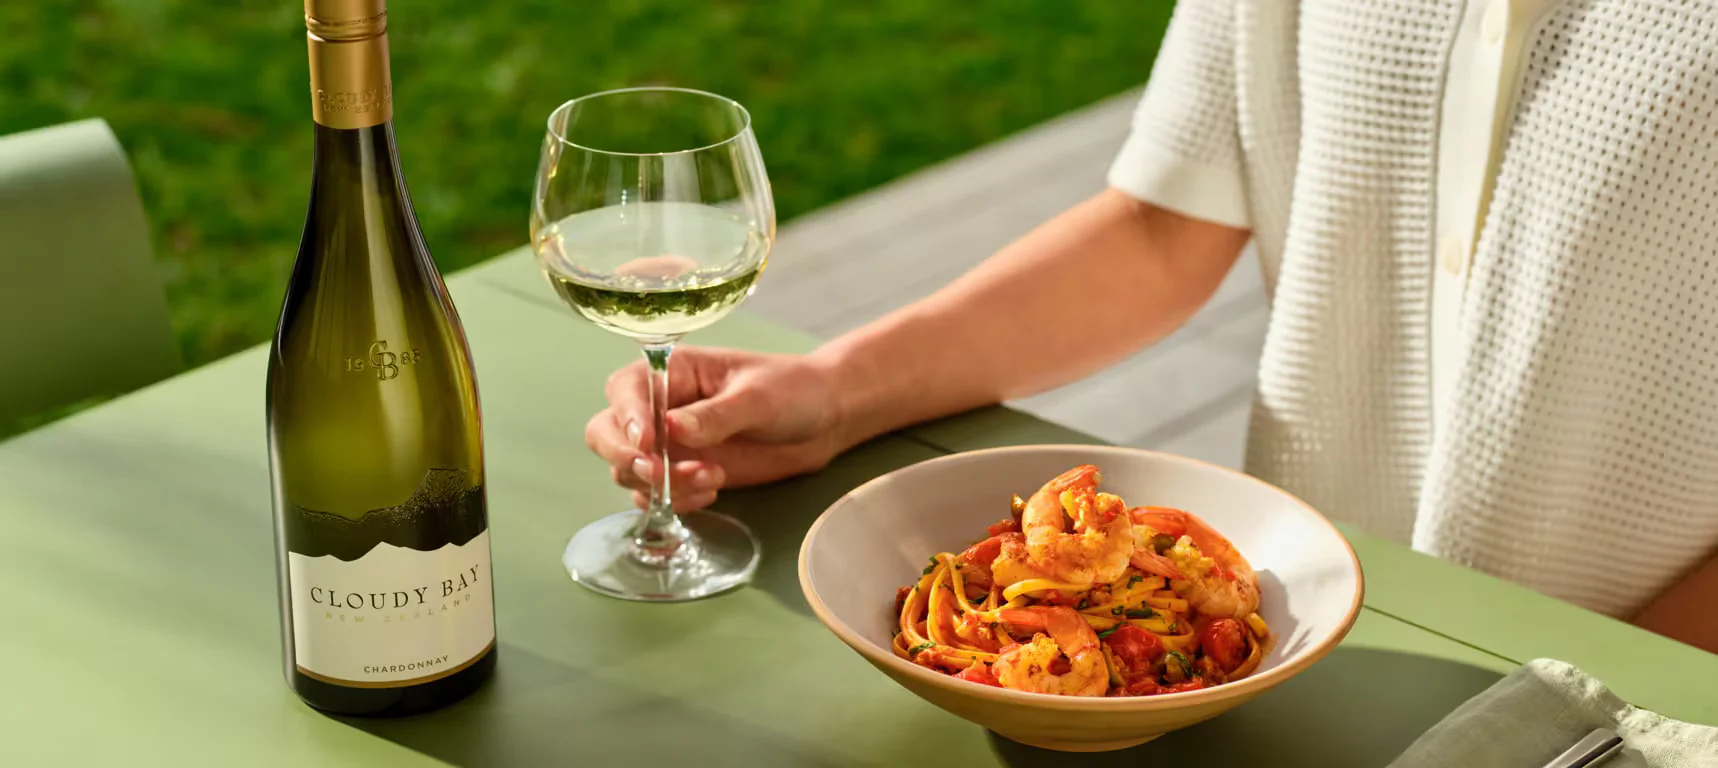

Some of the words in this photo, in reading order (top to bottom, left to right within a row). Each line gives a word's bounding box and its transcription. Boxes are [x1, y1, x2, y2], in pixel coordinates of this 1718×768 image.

[310, 586, 428, 610] CLOUDY
[441, 564, 480, 598] BAY
[325, 611, 365, 623] NEW
[383, 593, 472, 623] ZEALAND
[363, 655, 449, 674] CHARDONNAY
